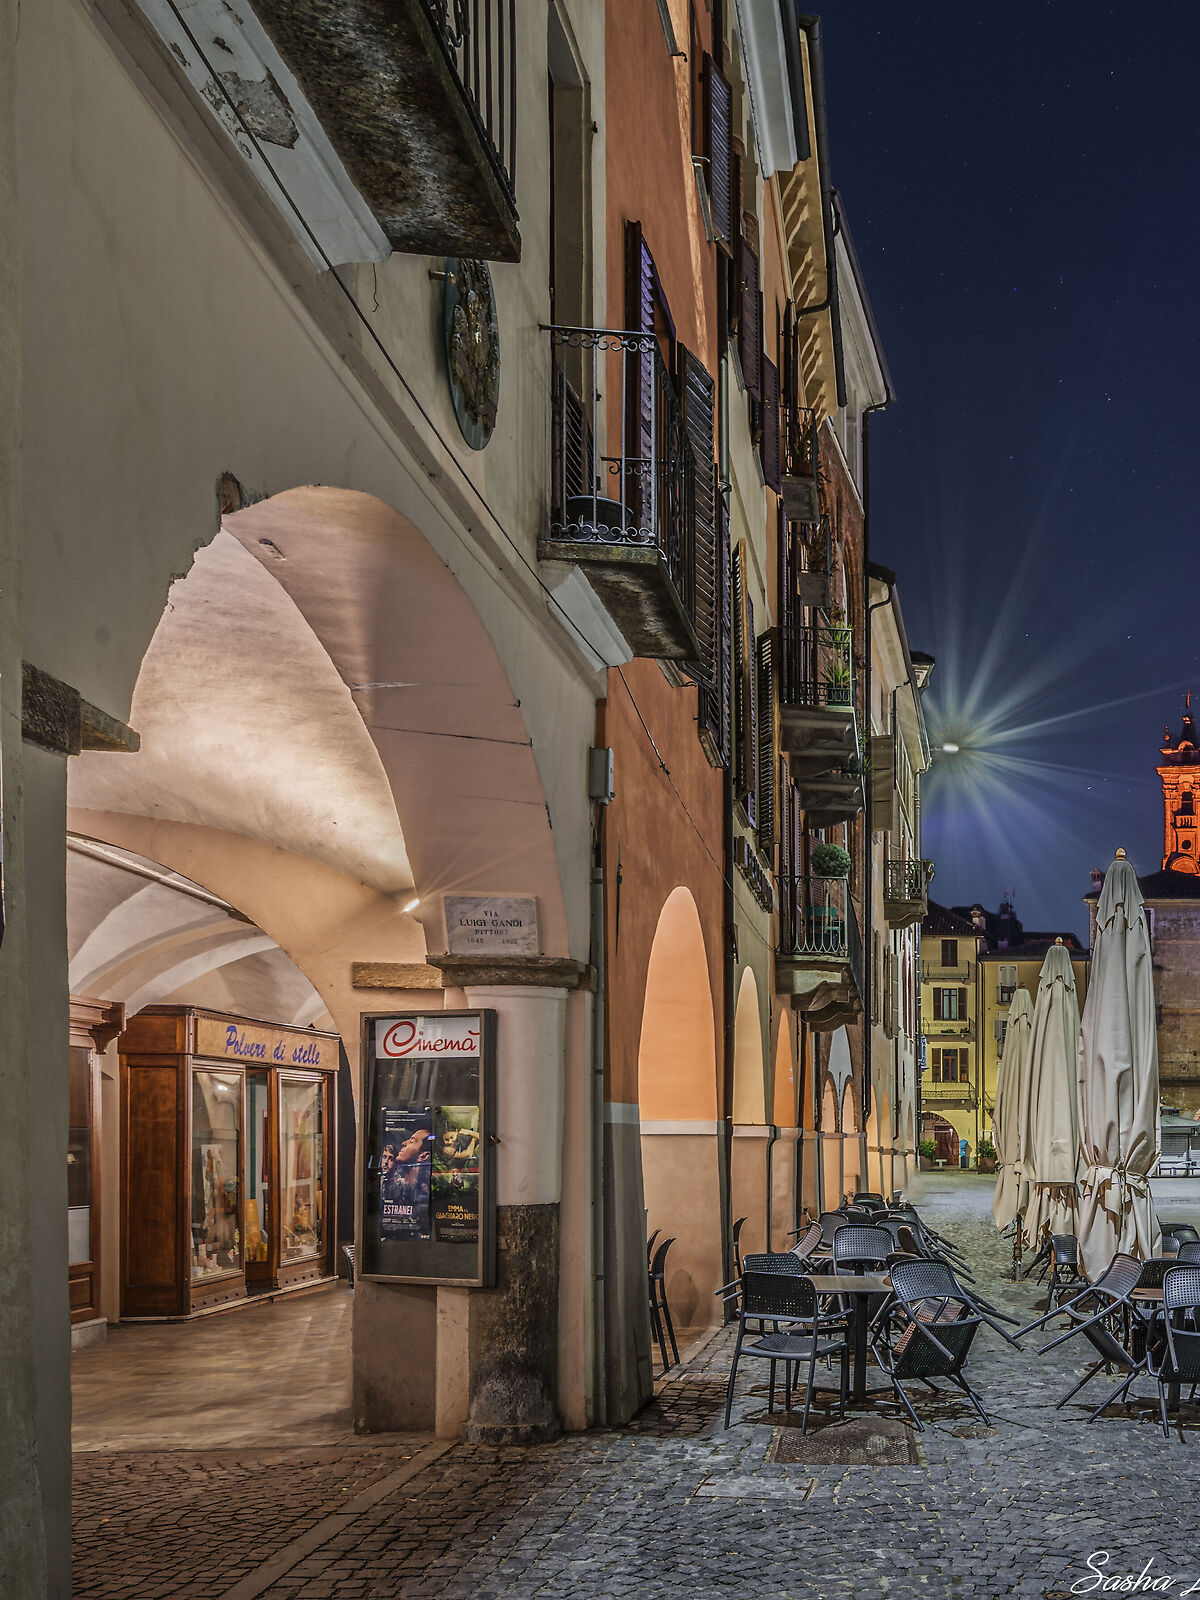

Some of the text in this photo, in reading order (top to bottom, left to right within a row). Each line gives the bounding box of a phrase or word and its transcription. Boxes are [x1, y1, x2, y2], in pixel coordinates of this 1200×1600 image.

[460, 919, 522, 928] LUIGI GANDI
[224, 1025, 320, 1065] Polvere di stelle
[383, 1204, 413, 1215] ESTRANEI
